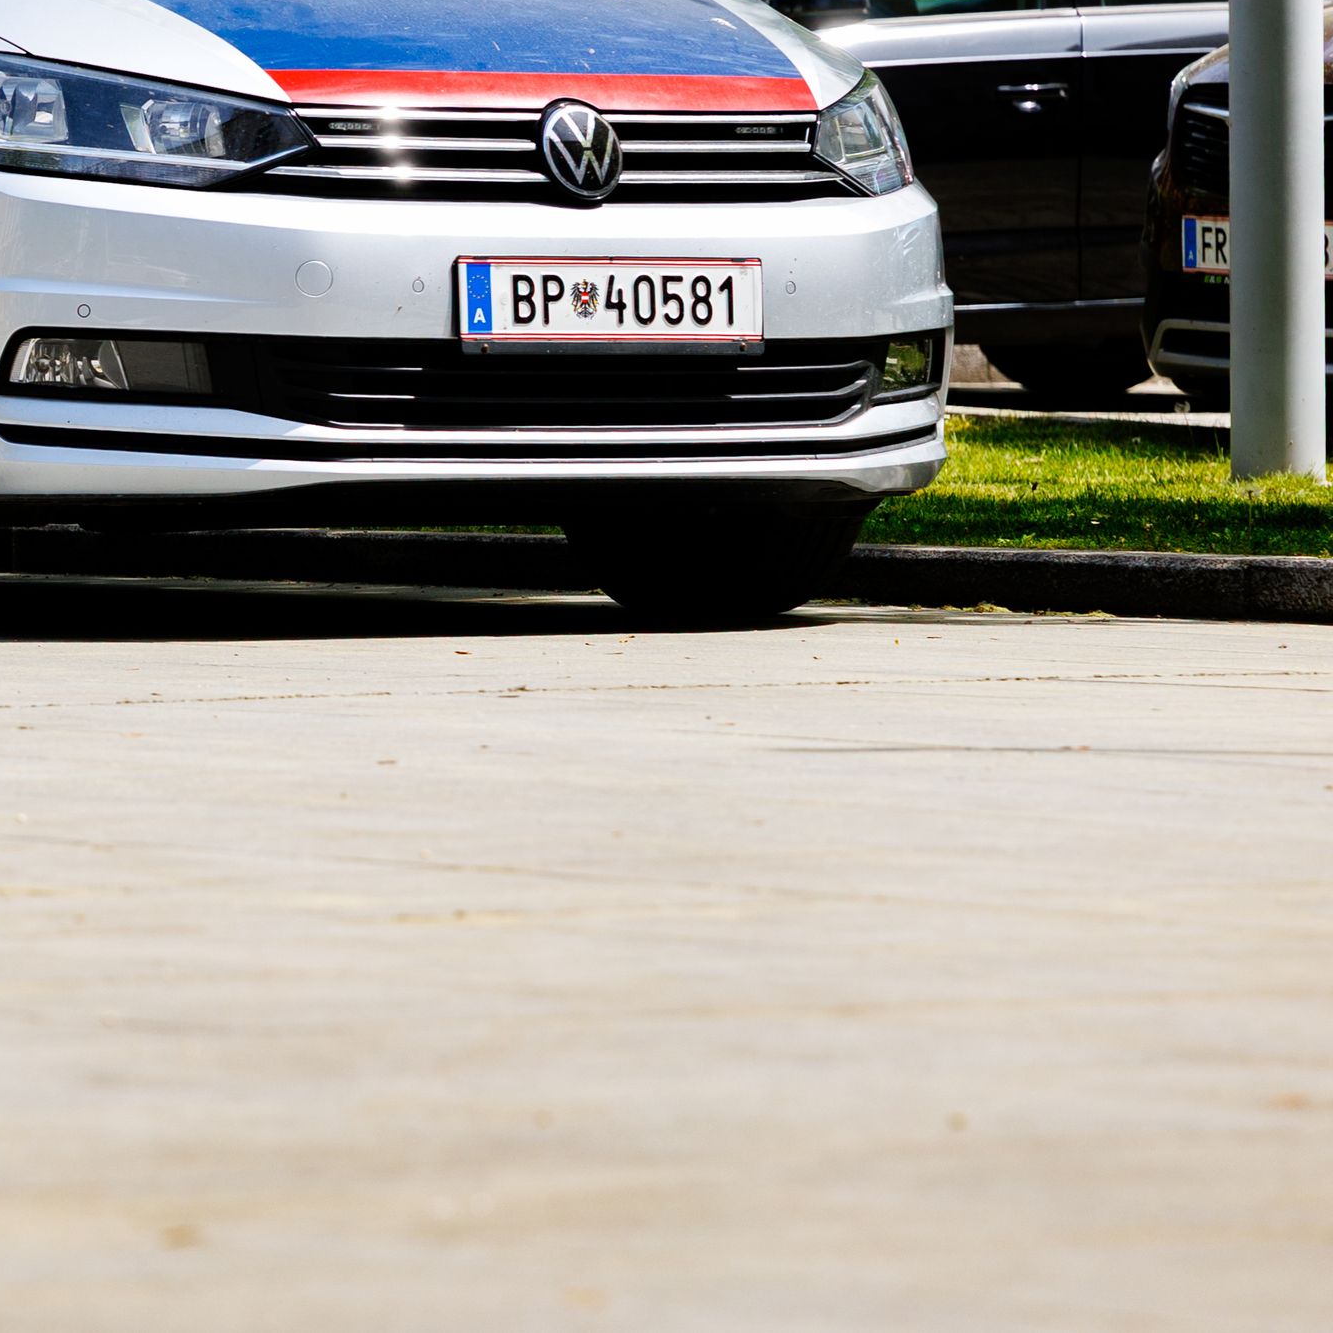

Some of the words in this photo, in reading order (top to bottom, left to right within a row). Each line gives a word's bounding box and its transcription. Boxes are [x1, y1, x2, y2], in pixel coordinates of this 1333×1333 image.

[473, 308, 487, 323] A
[510, 274, 565, 325] BP
[604, 274, 734, 326] 40581
